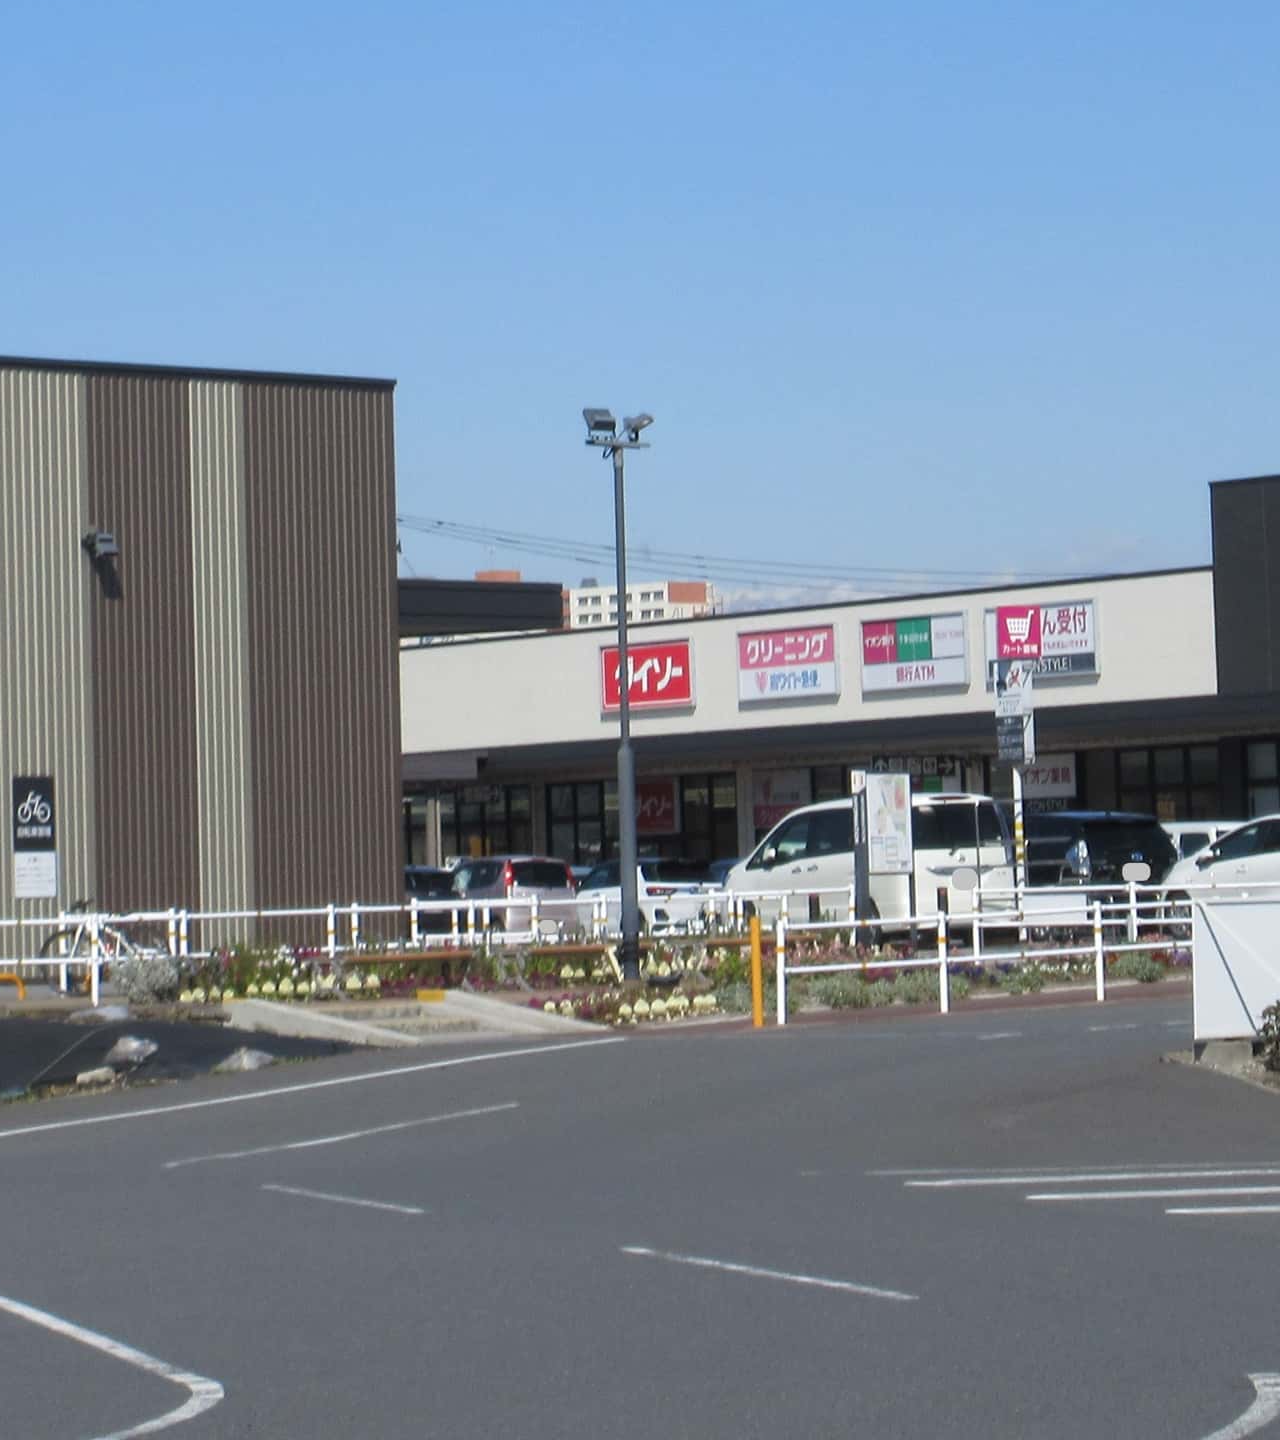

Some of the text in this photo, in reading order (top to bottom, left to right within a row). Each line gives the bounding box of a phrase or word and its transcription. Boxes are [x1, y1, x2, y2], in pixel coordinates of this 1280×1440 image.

[747, 631, 828, 665] クリーニング
